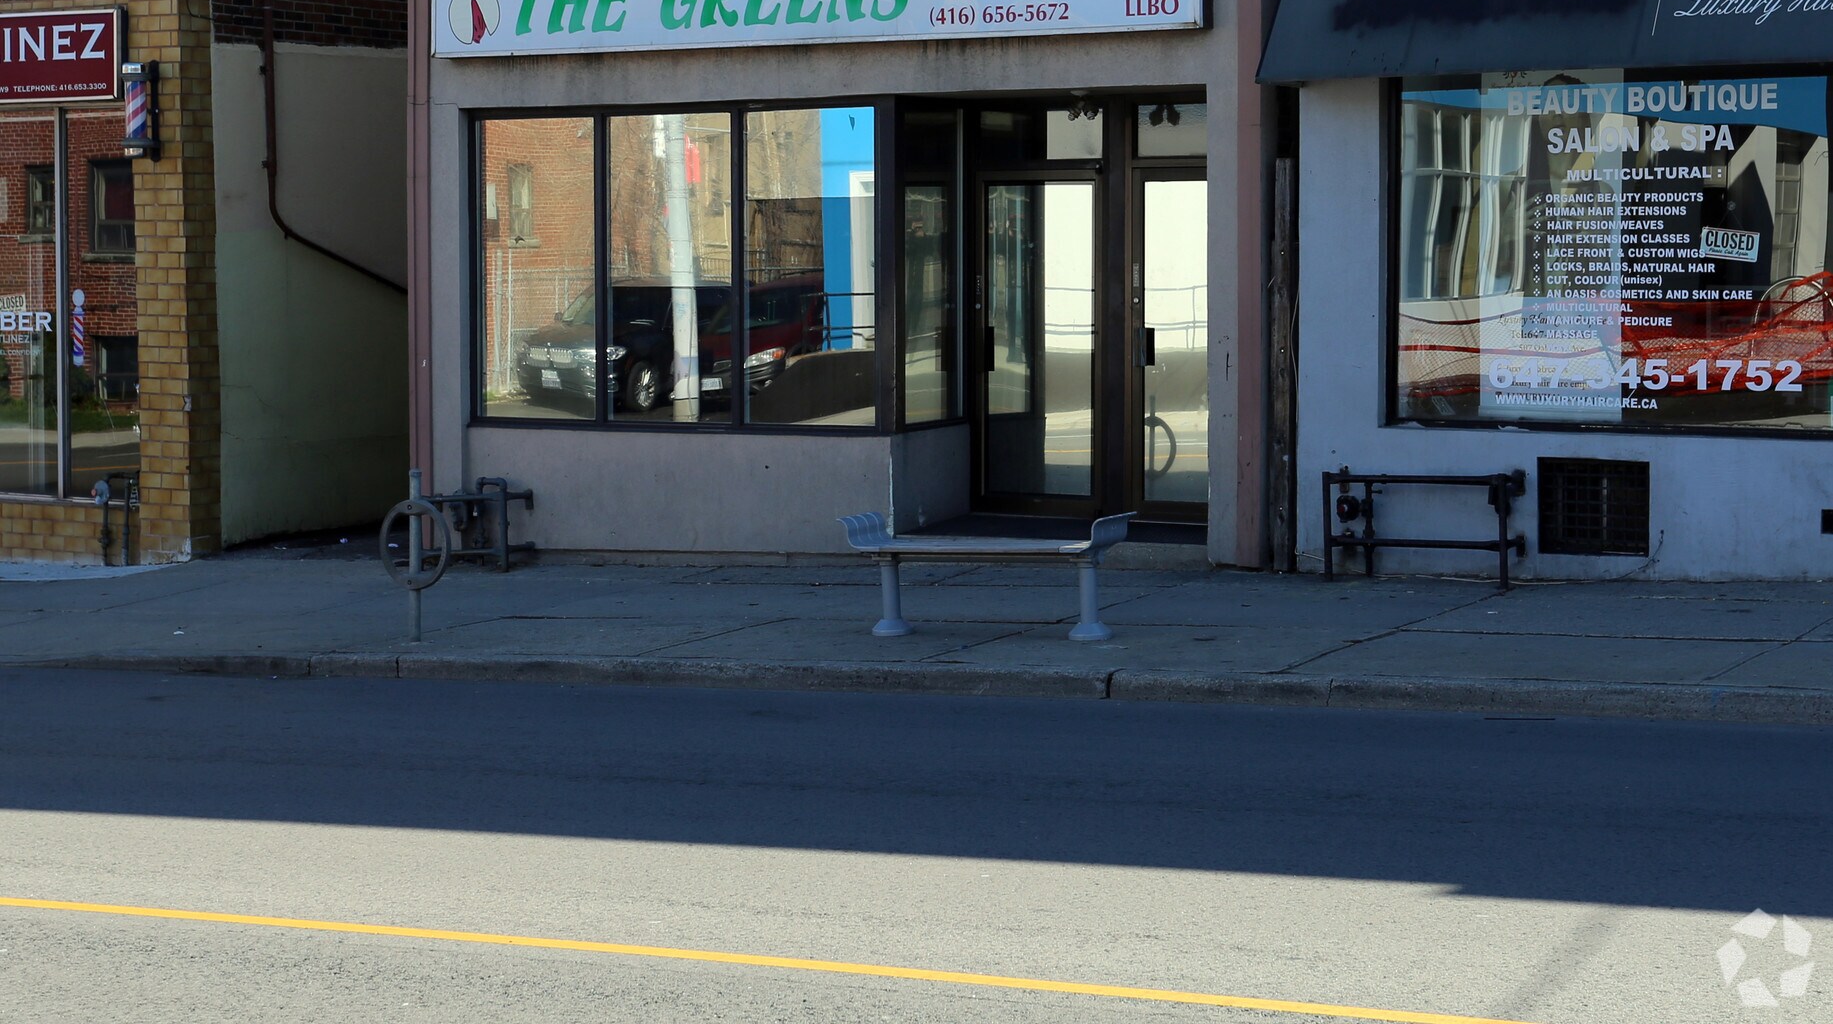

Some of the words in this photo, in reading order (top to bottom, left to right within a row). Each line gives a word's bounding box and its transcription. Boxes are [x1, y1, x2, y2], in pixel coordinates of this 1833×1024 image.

[929, 5, 976, 27] (416)
[982, 2, 1069, 24] 656-5672
[3, 23, 106, 63] INEZ
[13, 84, 58, 93] TELEPHONE:
[59, 82, 107, 91] 416.653.3300
[1507, 87, 1618, 116] BEAUTY
[1627, 82, 1779, 113] BOUTIQUE
[1547, 126, 1640, 154] SALON
[1650, 125, 1670, 152] &
[1680, 124, 1735, 151] SPA
[1567, 166, 1712, 181] MULTICULTURAL
[1545, 193, 1594, 203] ORGANIC
[1597, 193, 1641, 203] BEAUTY
[1644, 192, 1704, 202] PRODUCTS
[1545, 207, 1584, 217] HUMAN
[1588, 207, 1614, 216] HAIR
[1617, 206, 1687, 216] EXTENSIONS
[1547, 220, 1573, 230] HAIR
[1576, 220, 1664, 230] FUSION/WEAVES
[1547, 235, 1573, 244] HAIR
[1576, 234, 1638, 244] EXTENSION
[1641, 234, 1690, 244] CLASSES
[1705, 230, 1755, 251] CLOSED
[1547, 248, 1574, 258] LACE
[1577, 248, 1613, 258] FRONT
[1617, 249, 1625, 258] &
[1628, 248, 1674, 258] CUSTOM
[1677, 248, 1706, 258] WIGS
[1547, 262, 1586, 273] LOCKS,
[1589, 262, 1632, 273] BRAIDS,
[1633, 263, 1685, 273] NATURAL
[1688, 263, 1715, 273] HAIR
[1547, 276, 1572, 286] CUT,
[1575, 276, 1619, 285] COLOUR
[1620, 275, 1663, 286] (unisex)
[1547, 290, 1561, 298] AN
[1565, 289, 1597, 298] OASIS
[1600, 289, 1663, 299] COSMETICS
[1666, 290, 1689, 299] AND
[1692, 290, 1719, 300] SKIN
[1722, 290, 1753, 300] CARE
[1547, 303, 1633, 312] MULTICULTURAL
[1547, 316, 1603, 326] MANICURE
[1606, 317, 1614, 326] &
[1618, 317, 1672, 326] PEDICURE
[1547, 330, 1598, 339] MASSAGE
[1488, 358, 1803, 392] 647-345-1752
[1495, 394, 1658, 410] WWW.LUXURYHAIRCARE.CA
